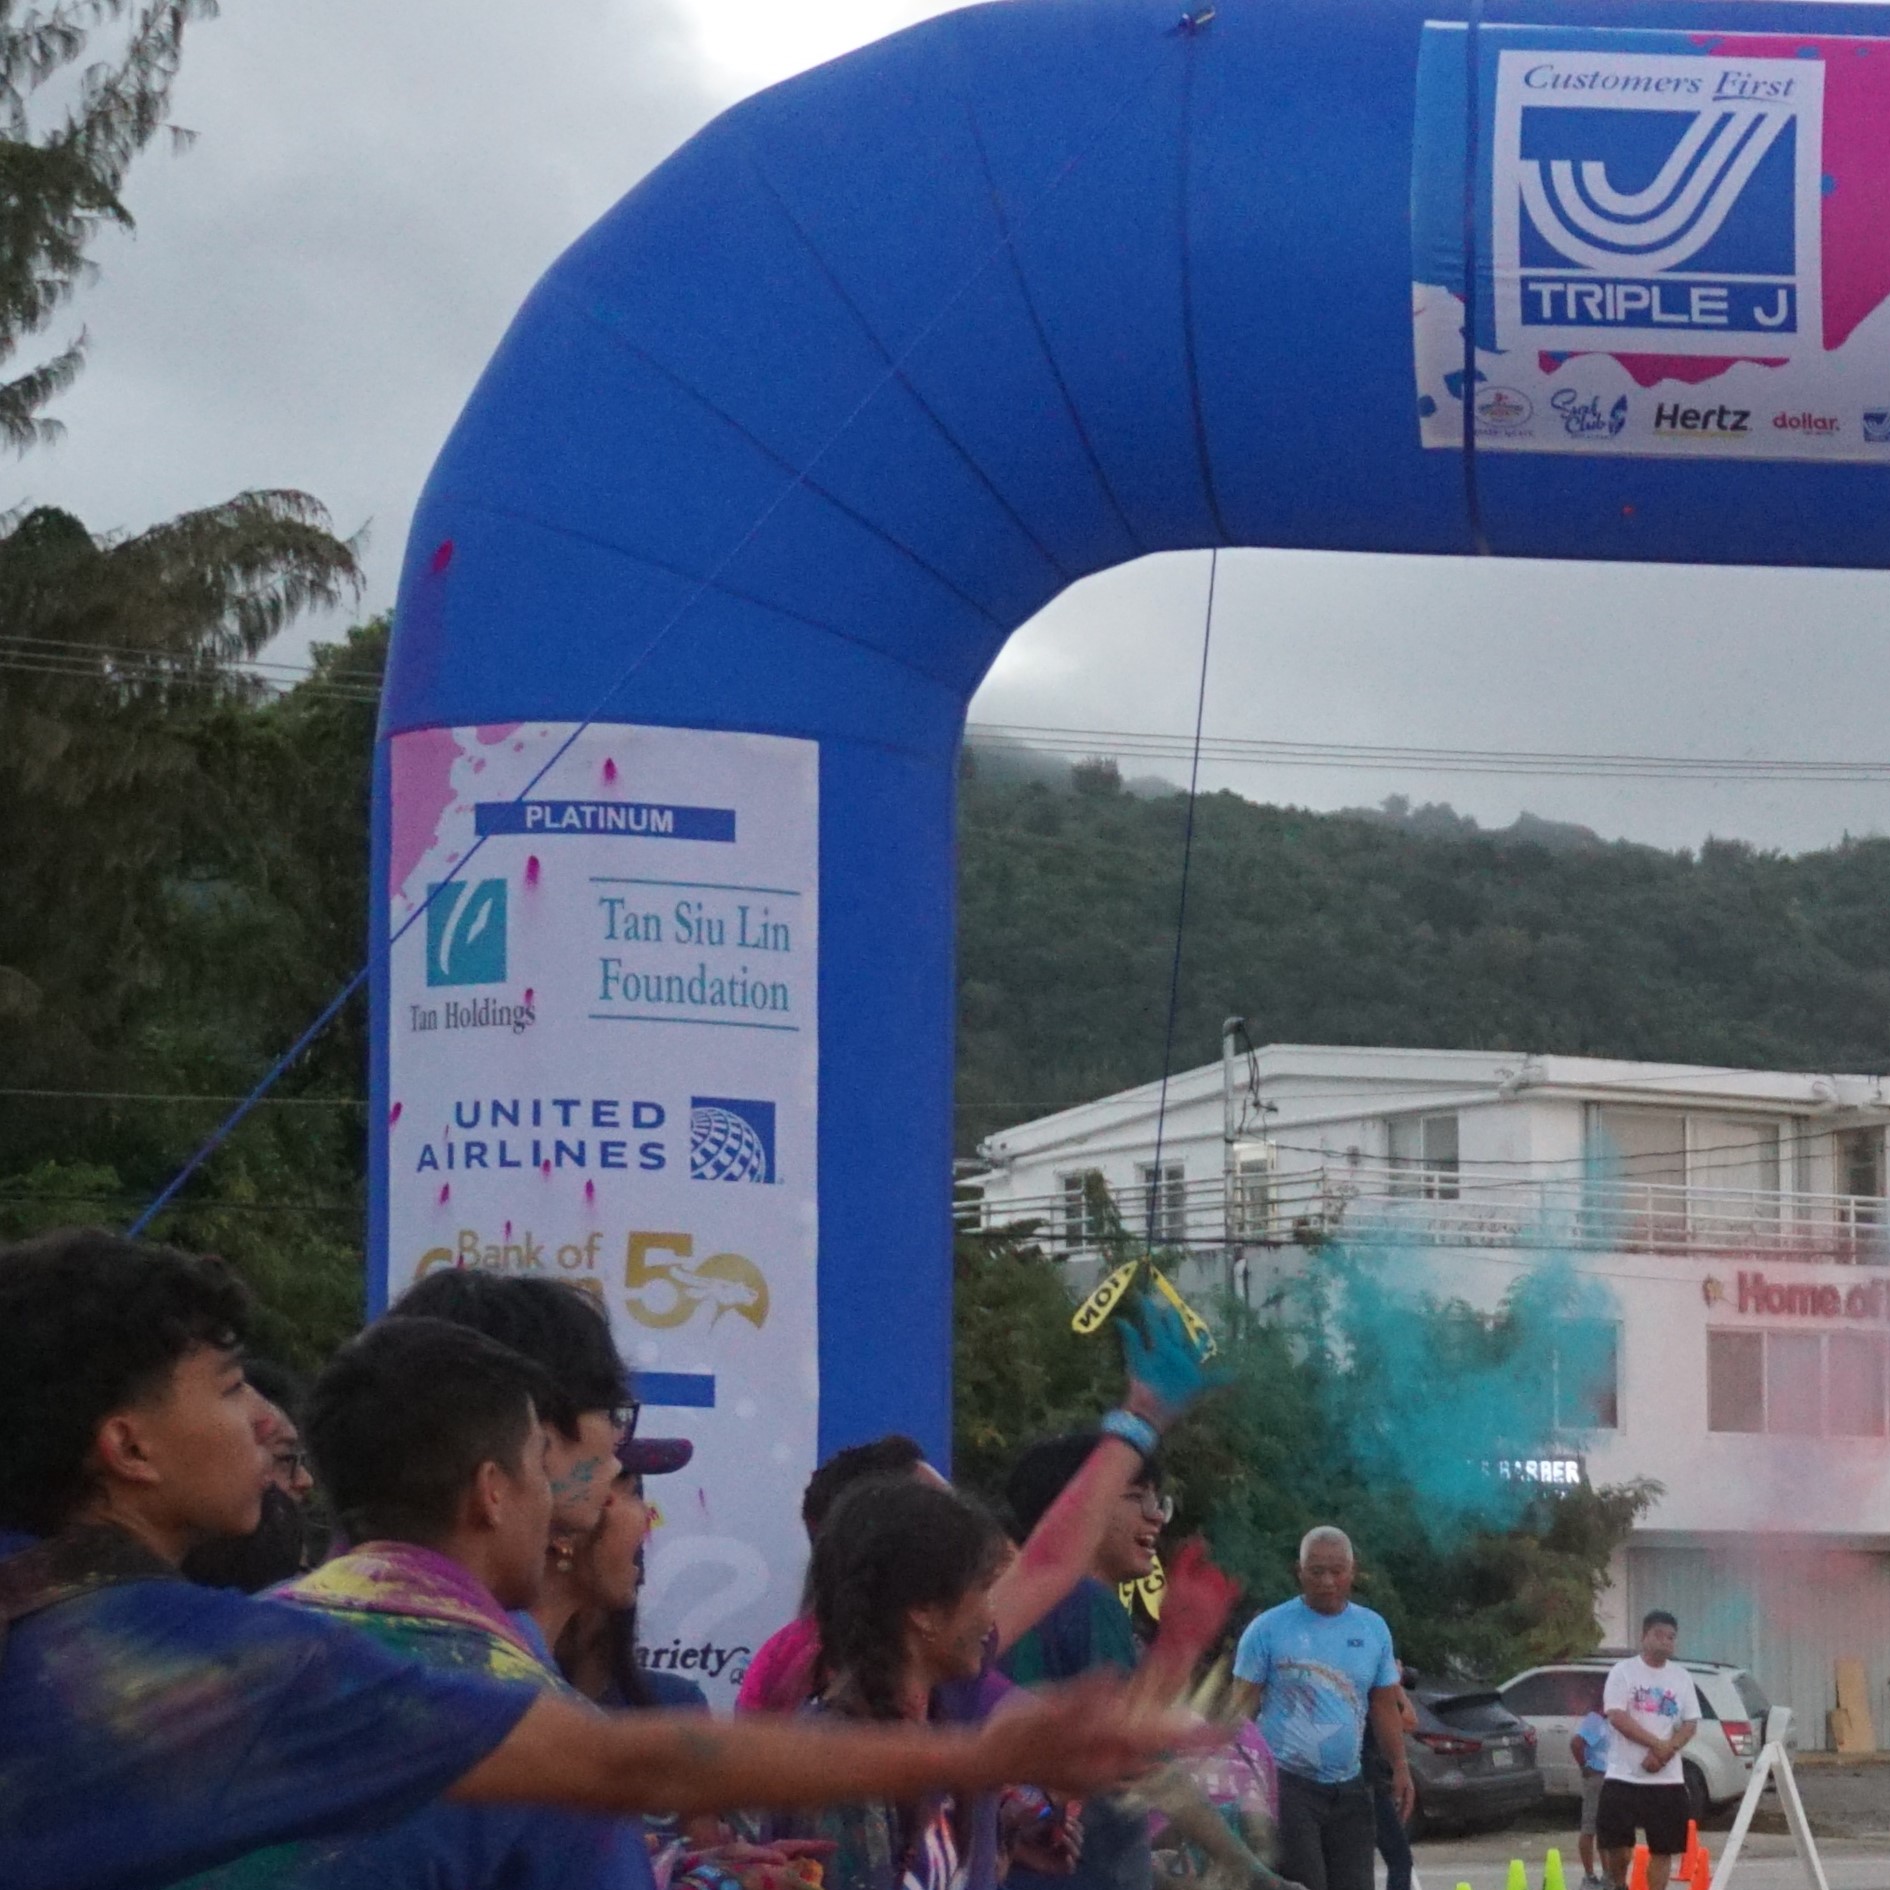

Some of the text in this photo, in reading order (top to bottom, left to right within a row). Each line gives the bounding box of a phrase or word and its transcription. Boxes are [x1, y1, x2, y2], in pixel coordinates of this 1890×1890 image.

[1524, 63, 1795, 104] Customers First
[1528, 282, 1788, 327] TRIPLE J
[1653, 401, 1752, 432] Hertz
[525, 805, 674, 833] PLATINUM
[600, 897, 791, 952] Tan Siu Lin
[599, 957, 790, 1012] Foundation
[411, 997, 537, 1036] Tan Holdings
[455, 1098, 667, 1129] UNITED
[416, 1140, 668, 1173] AIRLINES
[457, 1230, 604, 1271] Bank of
[1737, 1270, 1841, 1317] Home
[635, 1638, 751, 1678] ariety
